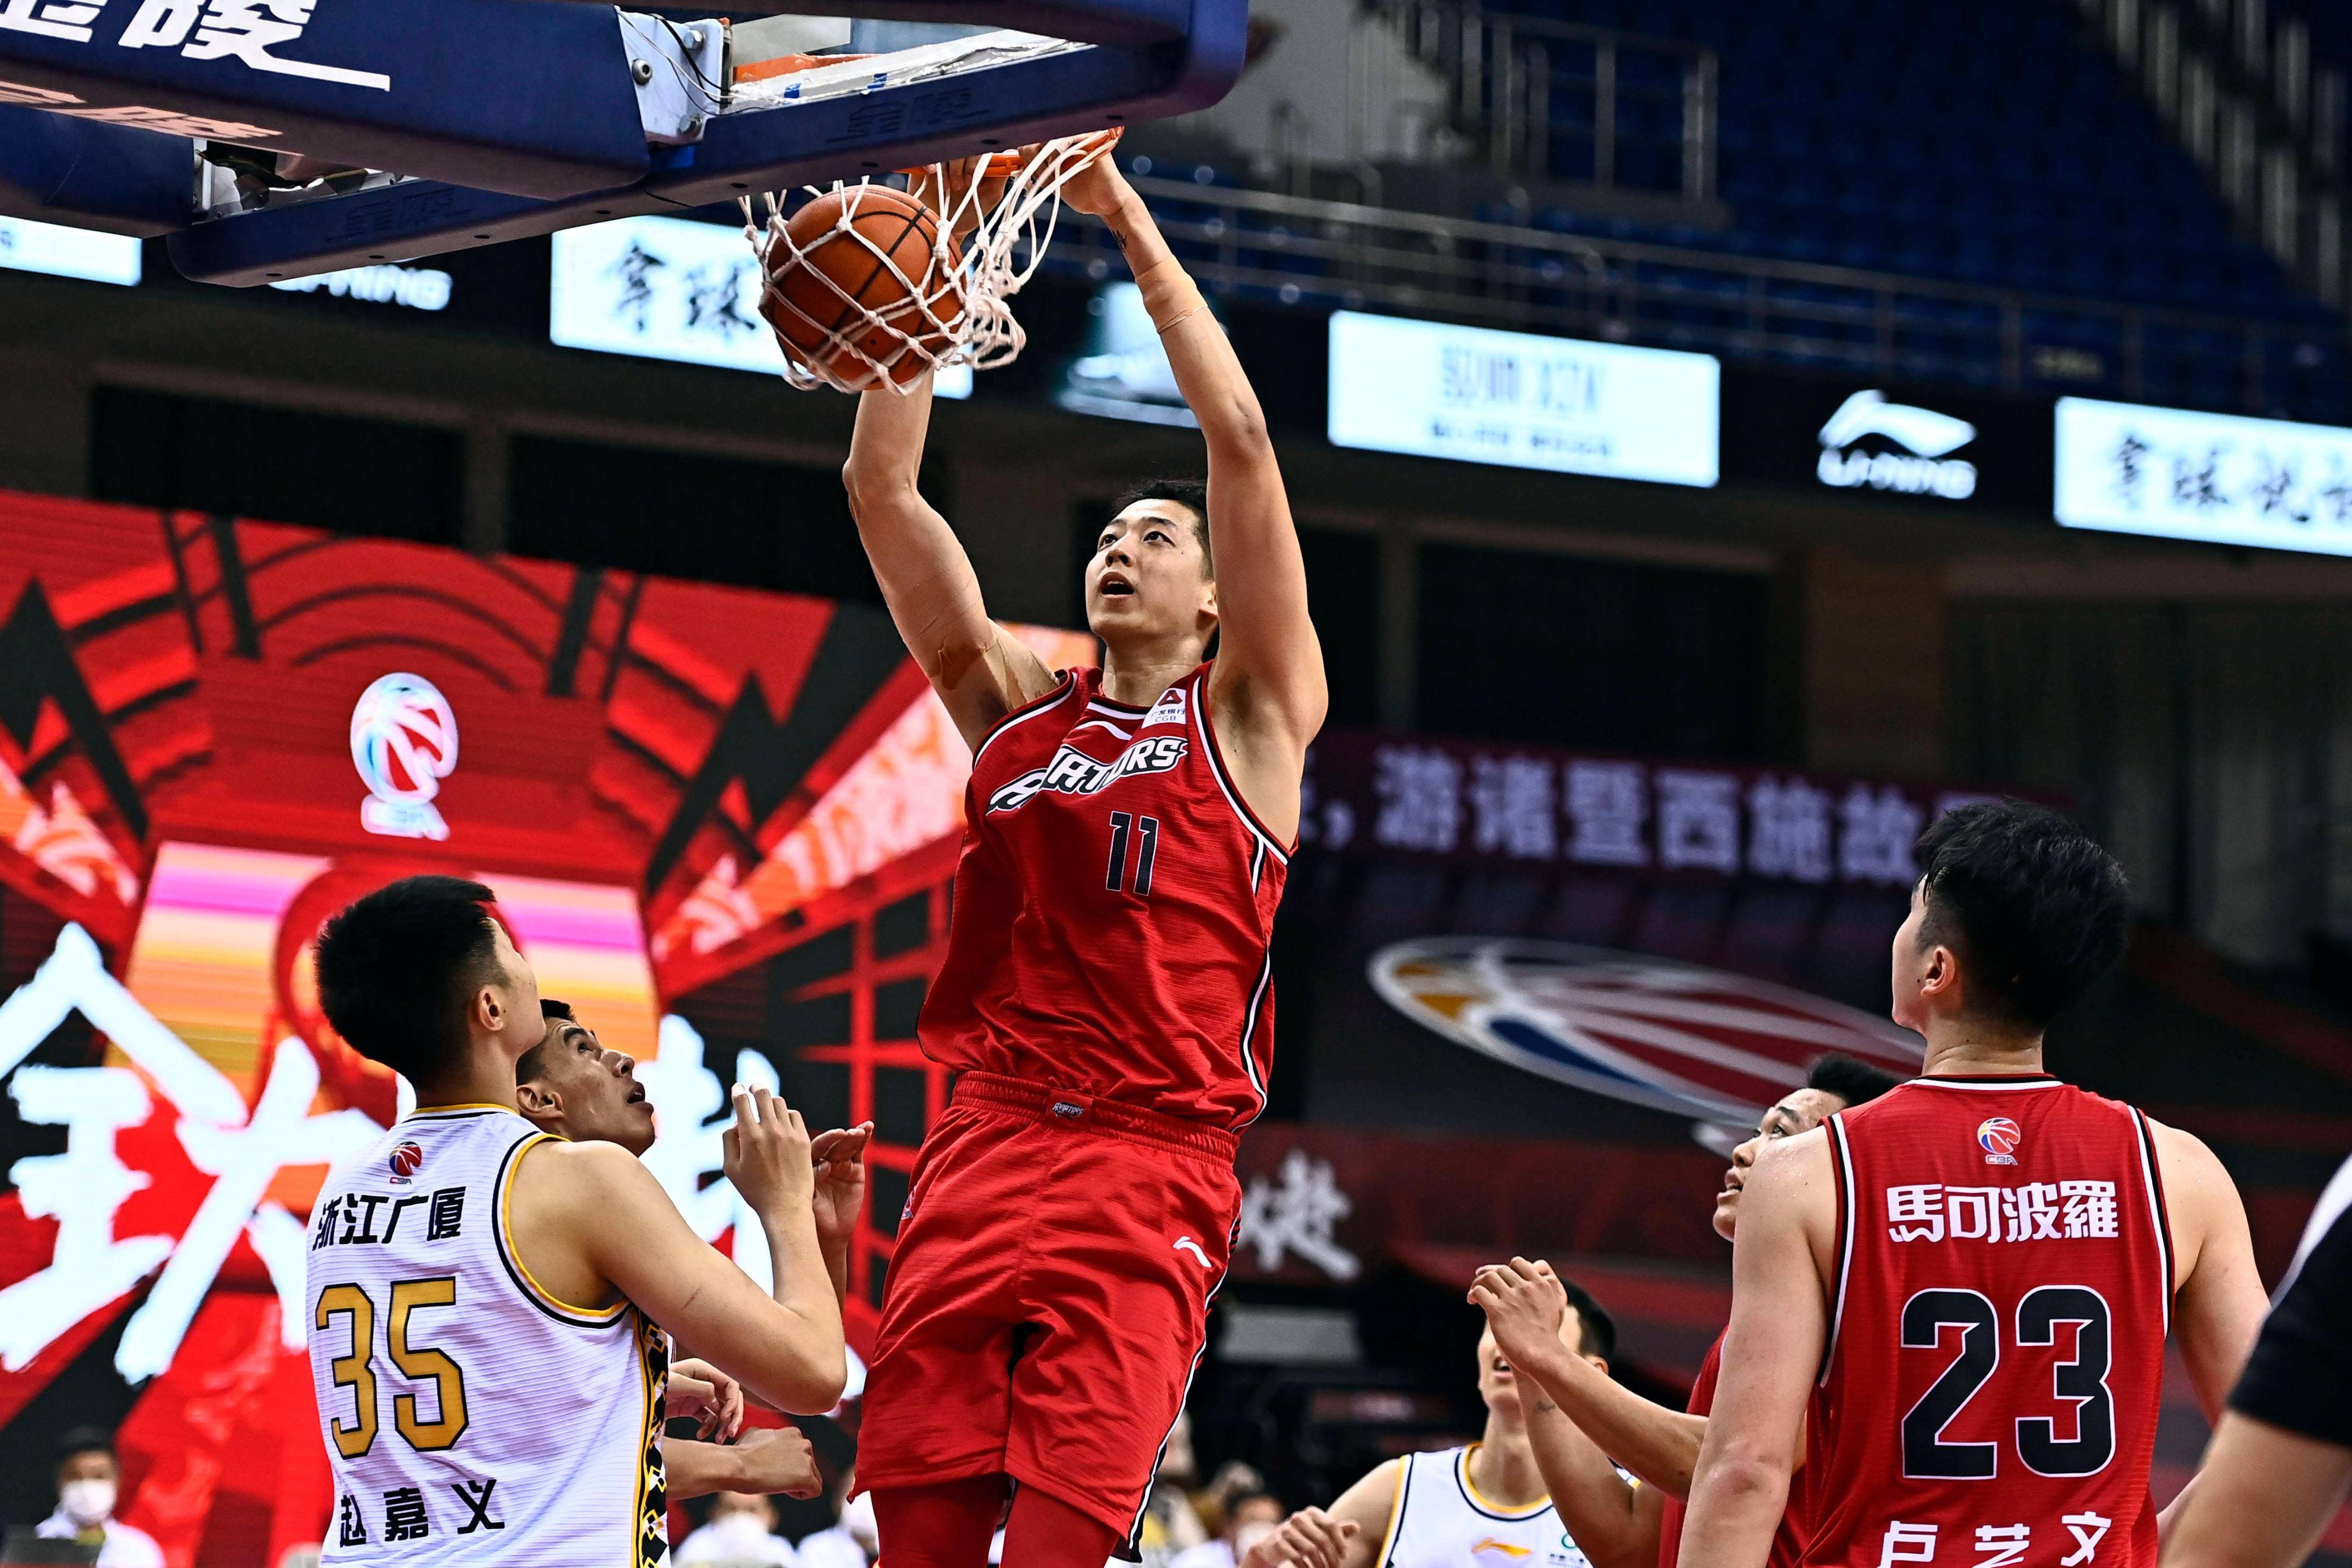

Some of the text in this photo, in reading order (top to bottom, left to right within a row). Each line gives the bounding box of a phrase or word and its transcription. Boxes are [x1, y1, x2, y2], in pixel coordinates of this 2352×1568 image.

[1106, 810, 1159, 896] 11
[390, 1177, 412, 1185] CBA
[1985, 1154, 2018, 1165] CBA
[312, 1185, 466, 1251] 浙江广厦
[1886, 1180, 2119, 1244] 馬可波羅
[315, 1276, 470, 1461] 35
[1901, 1285, 2116, 1480] 23
[339, 1478, 505, 1548] 赵嘉义
[1876, 1510, 2112, 1568] 卢艺文
